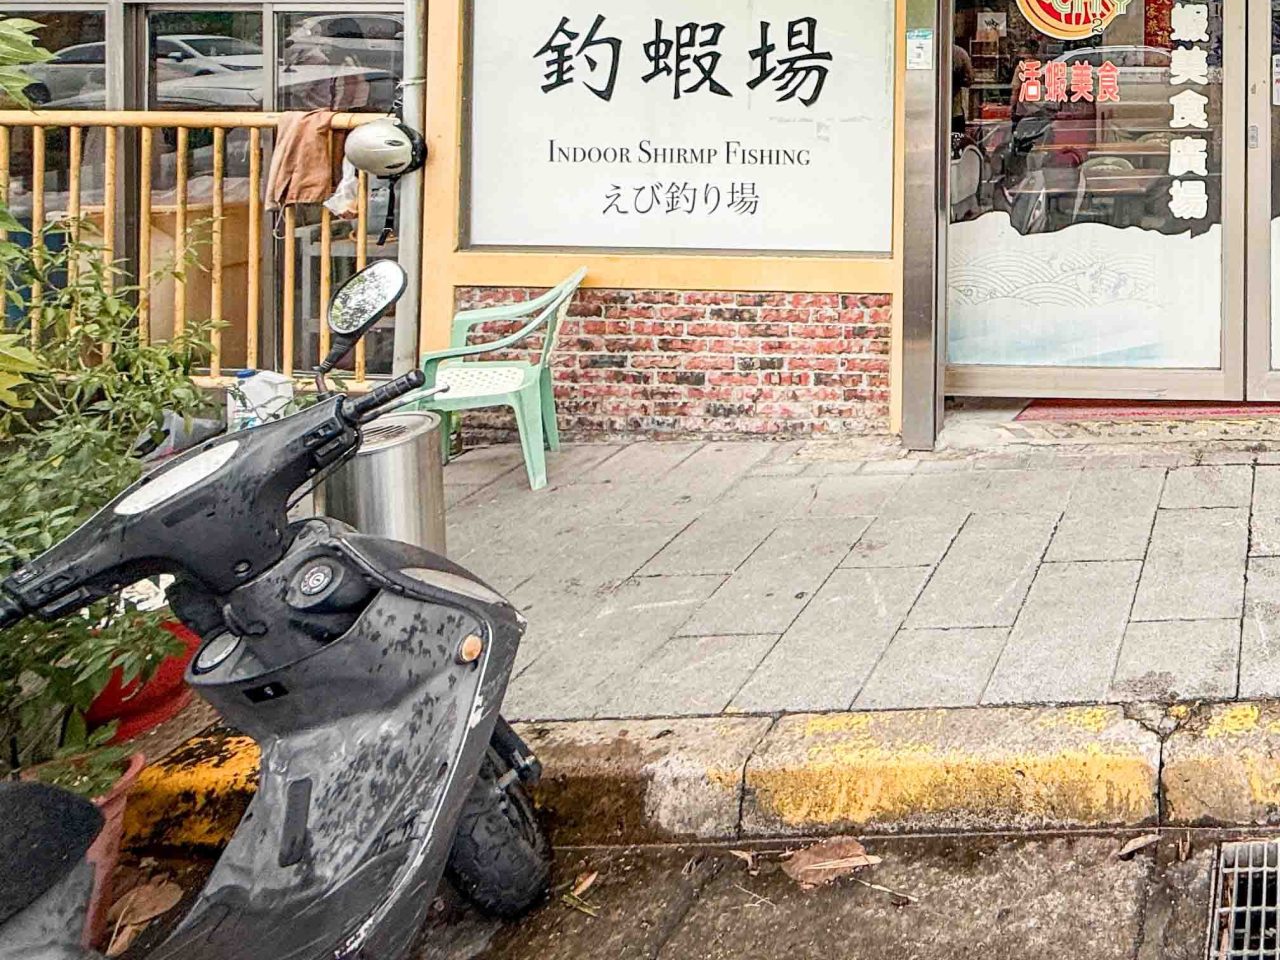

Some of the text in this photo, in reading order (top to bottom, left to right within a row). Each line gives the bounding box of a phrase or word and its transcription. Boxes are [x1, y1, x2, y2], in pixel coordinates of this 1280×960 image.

[532, 14, 834, 108] 釣蝦場
[1018, 60, 1121, 103] 活蝦美食
[602, 181, 760, 217] えび釣り場
